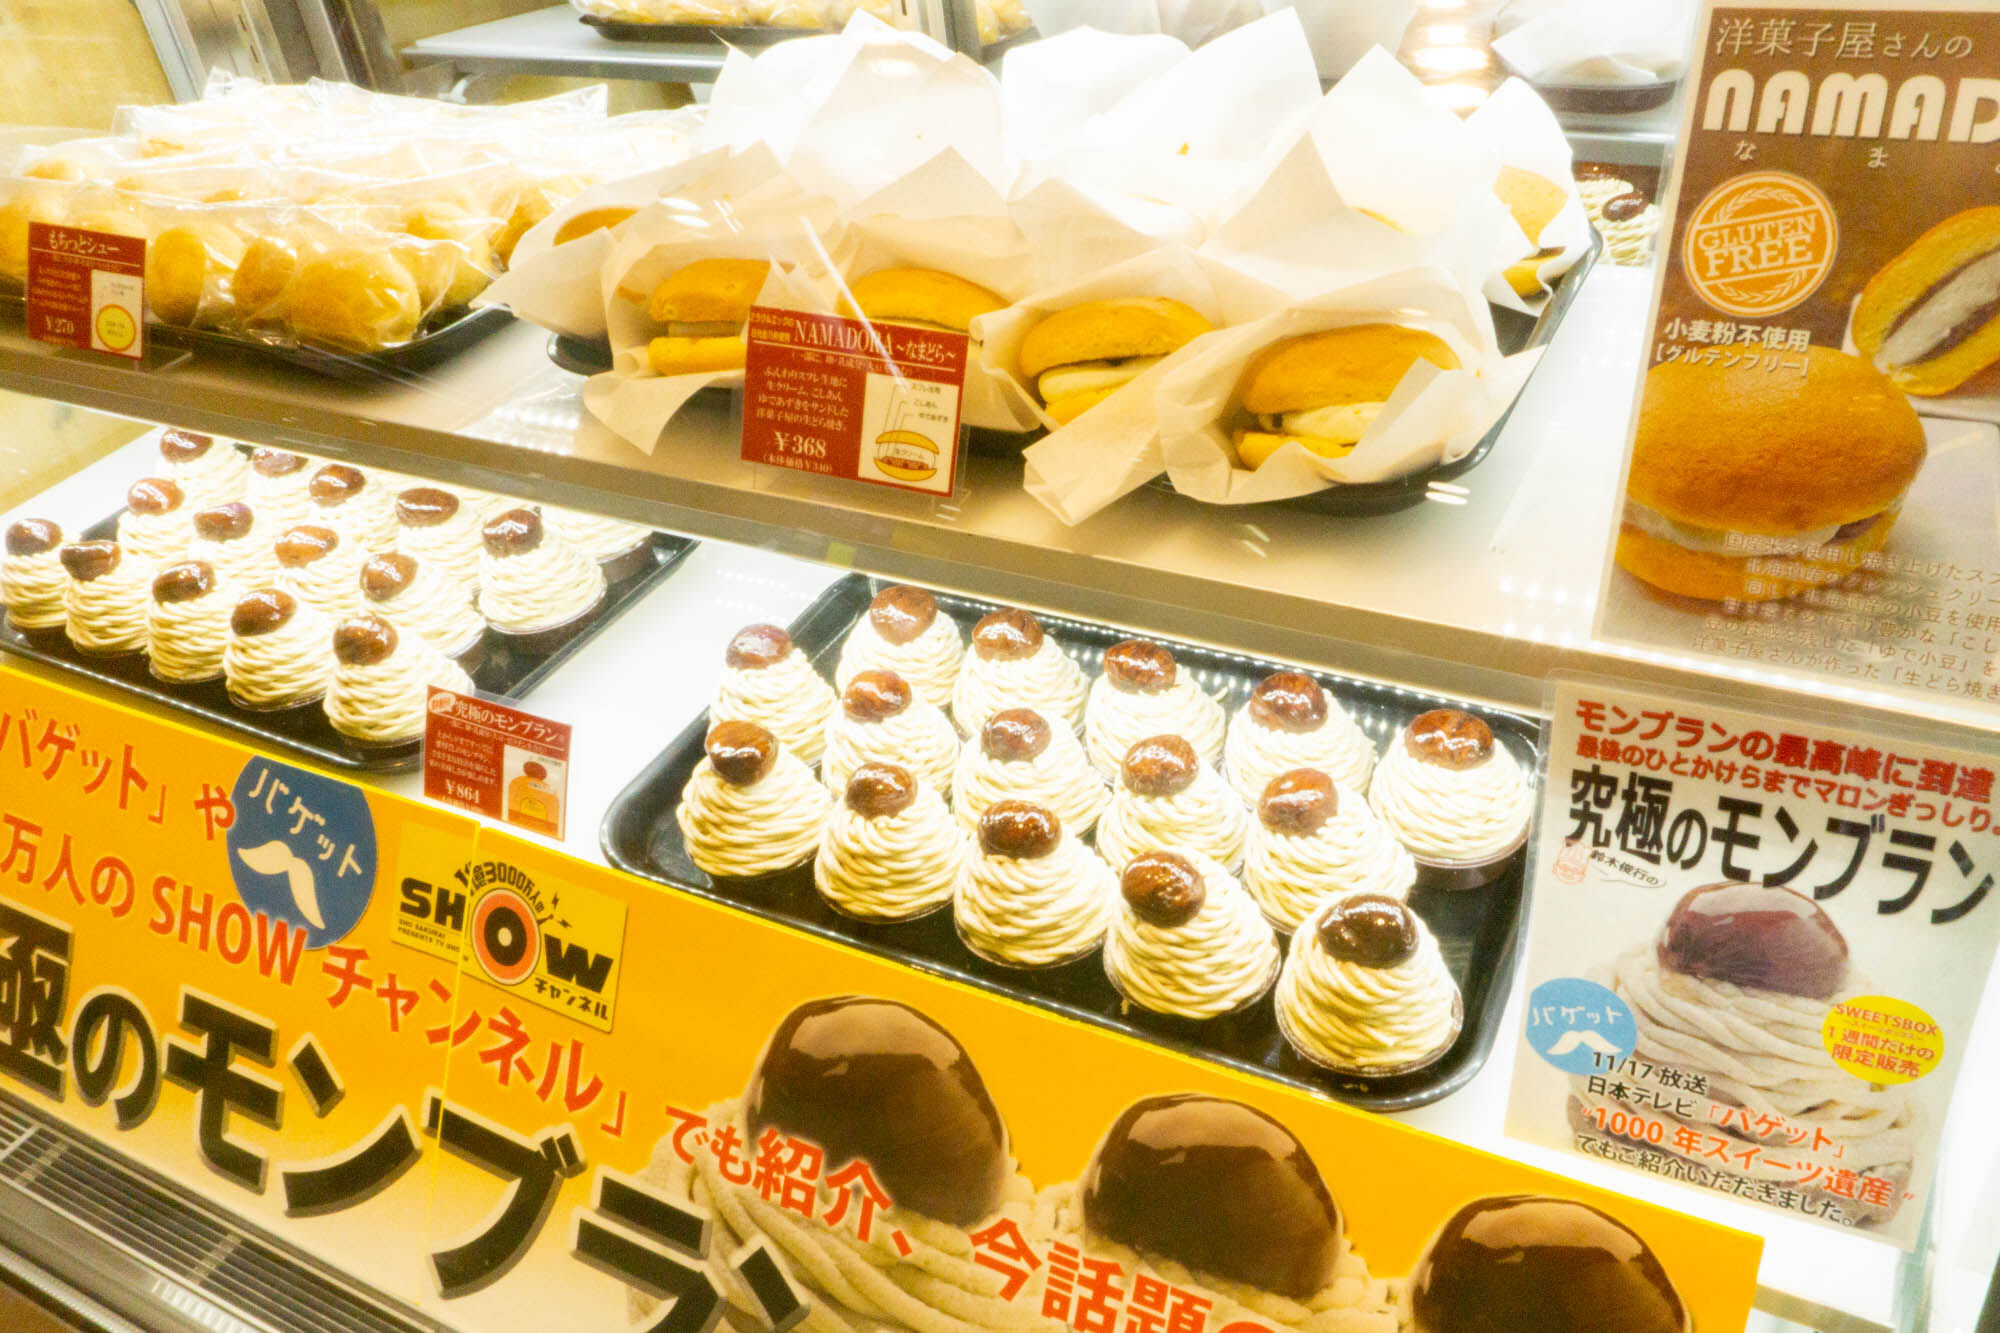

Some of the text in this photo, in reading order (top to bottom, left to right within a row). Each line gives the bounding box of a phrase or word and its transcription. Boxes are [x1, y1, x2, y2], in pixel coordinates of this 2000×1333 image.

[1716, 18, 1973, 59] 洋菓子屋さんの
[1697, 212, 1818, 252] GLUTEN
[1704, 234, 1813, 279] FREE
[1664, 318, 1811, 353] 小麦粉不使用
[774, 431, 826, 458] ¥368
[455, 699, 558, 743] 究極のモンブラン
[1575, 700, 1996, 805] モンブランの最高峰に到達
[248, 768, 363, 878] バゲット
[1565, 764, 1995, 925] 究極のモンブラン
[149, 875, 308, 987] SHOW
[400, 876, 614, 995] SHOW
[534, 976, 610, 1021] チャンネル
[1531, 1005, 1624, 1026] バゲット
[1836, 1003, 1937, 1036] SWEETSBOX
[1592, 1051, 1708, 1096] 11/17 放送
[1832, 1043, 1921, 1078] 限定販売
[1576, 1133, 1856, 1229] でもご紹介いただきました。
